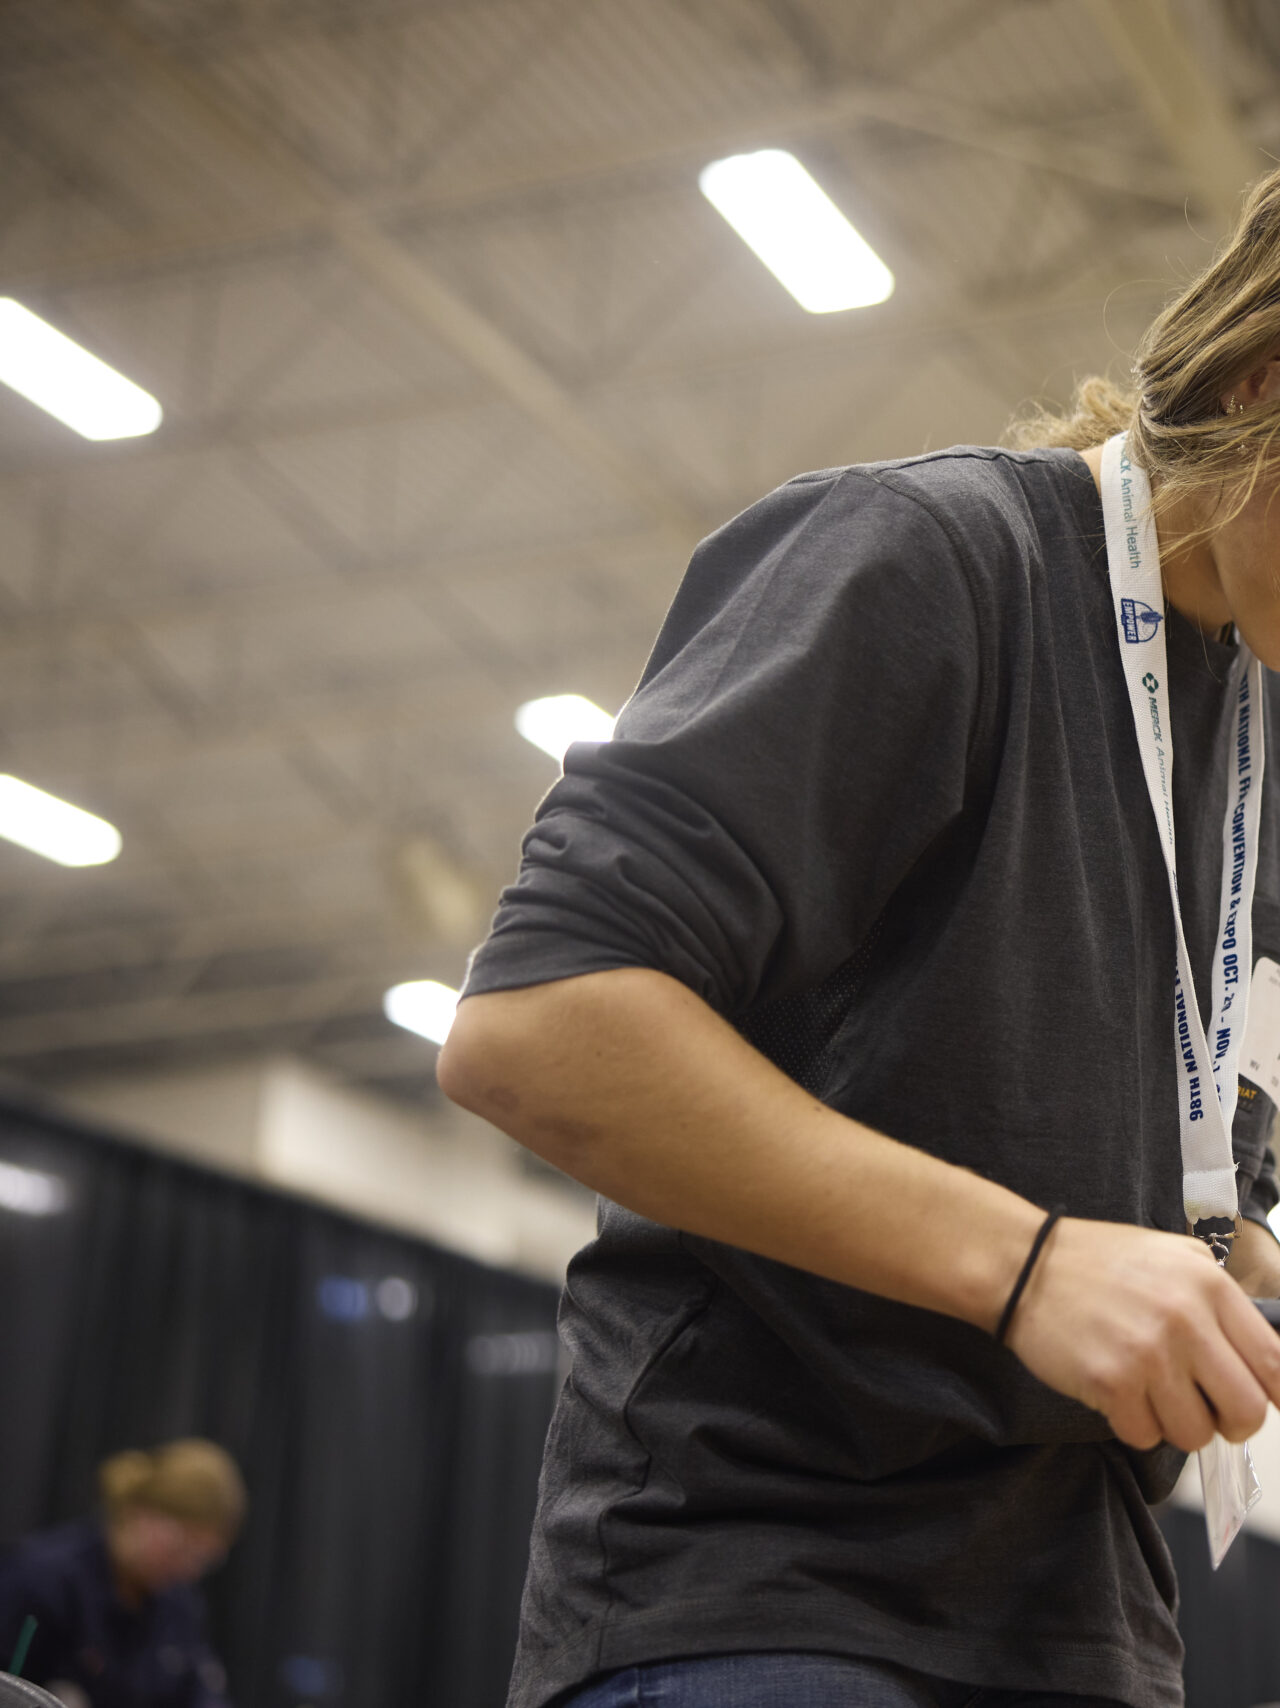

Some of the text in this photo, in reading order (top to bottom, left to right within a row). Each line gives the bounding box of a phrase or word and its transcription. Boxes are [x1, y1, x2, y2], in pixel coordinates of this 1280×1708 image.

[1121, 477, 1137, 523] Animal
[1126, 526, 1142, 569] Health
[1123, 601, 1137, 642] EMPOWER
[1148, 696, 1163, 743] MERCK
[1156, 746, 1169, 798] Animal
[1237, 704, 1252, 777] NATIONAL
[1231, 802, 1246, 896] CONVENTION
[1222, 910, 1238, 950] EXPO
[1223, 953, 1239, 992] OCT.
[1174, 989, 1199, 1074] NATIONAL
[1189, 1076, 1205, 1122] 98TH
